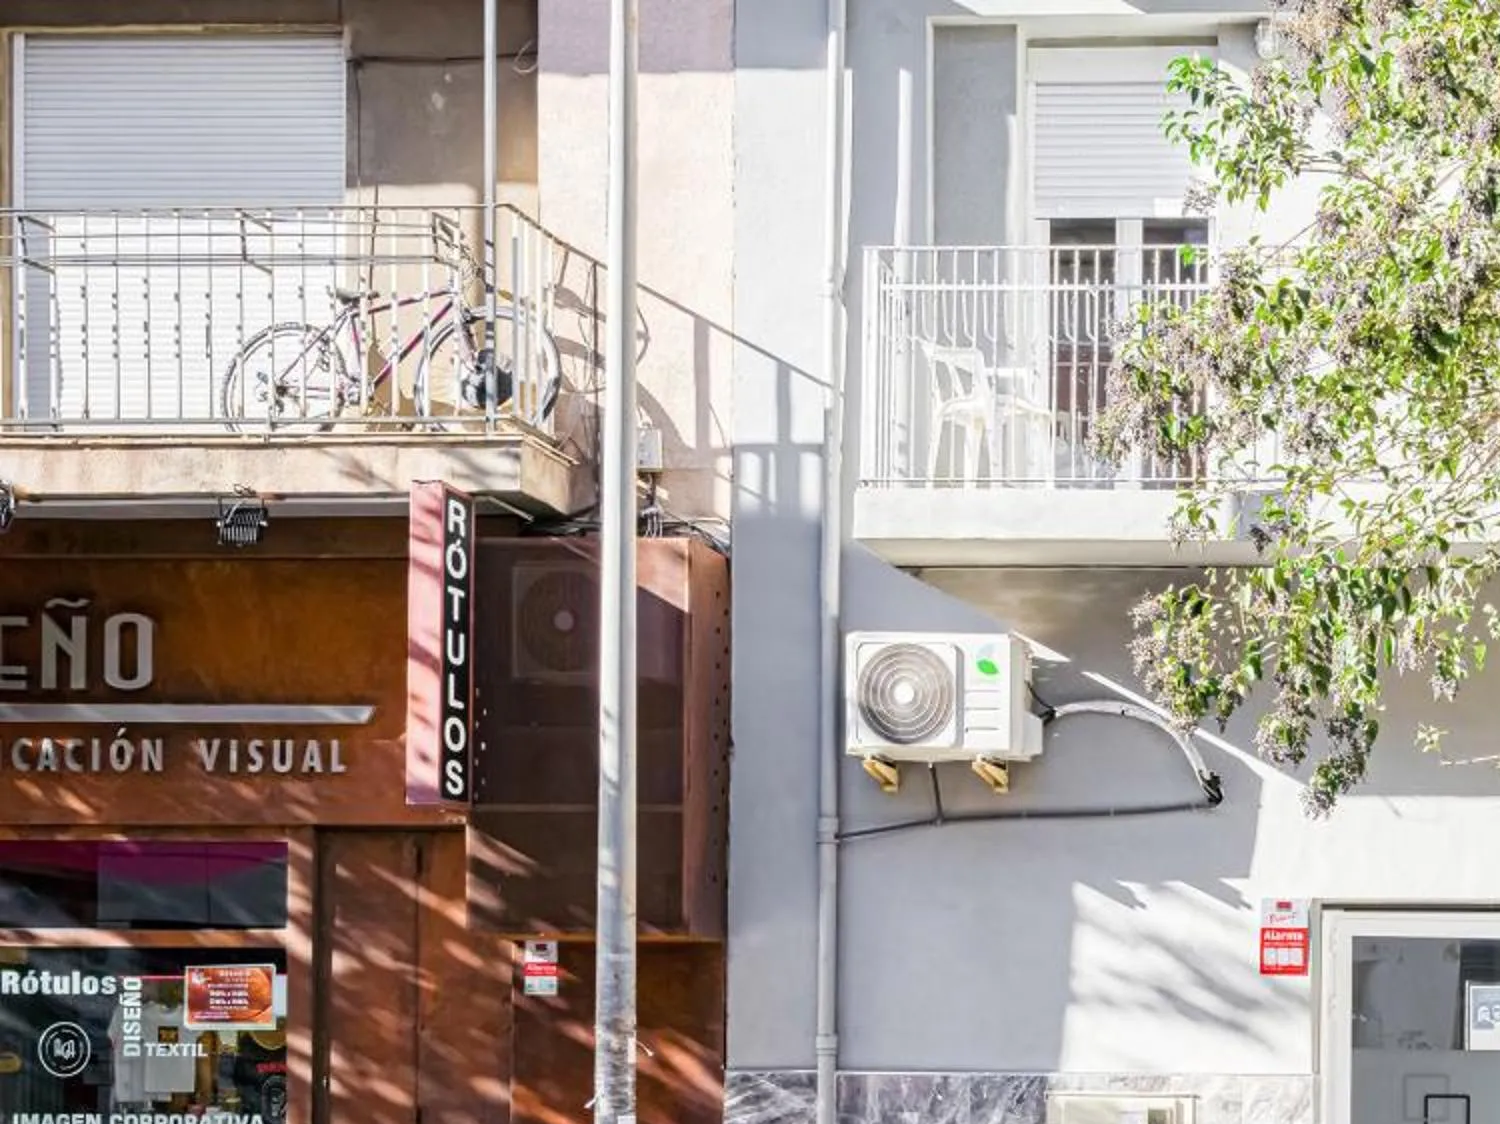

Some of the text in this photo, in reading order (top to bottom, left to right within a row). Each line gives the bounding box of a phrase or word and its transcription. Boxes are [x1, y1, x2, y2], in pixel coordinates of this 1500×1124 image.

[444, 499, 467, 796] RÓTULOS
[0, 728, 348, 773] CACIÓN VISUAL
[0, 970, 117, 995] Rótulos
[119, 976, 142, 1057] DISEÑO
[144, 1042, 208, 1057] TEXTIL
